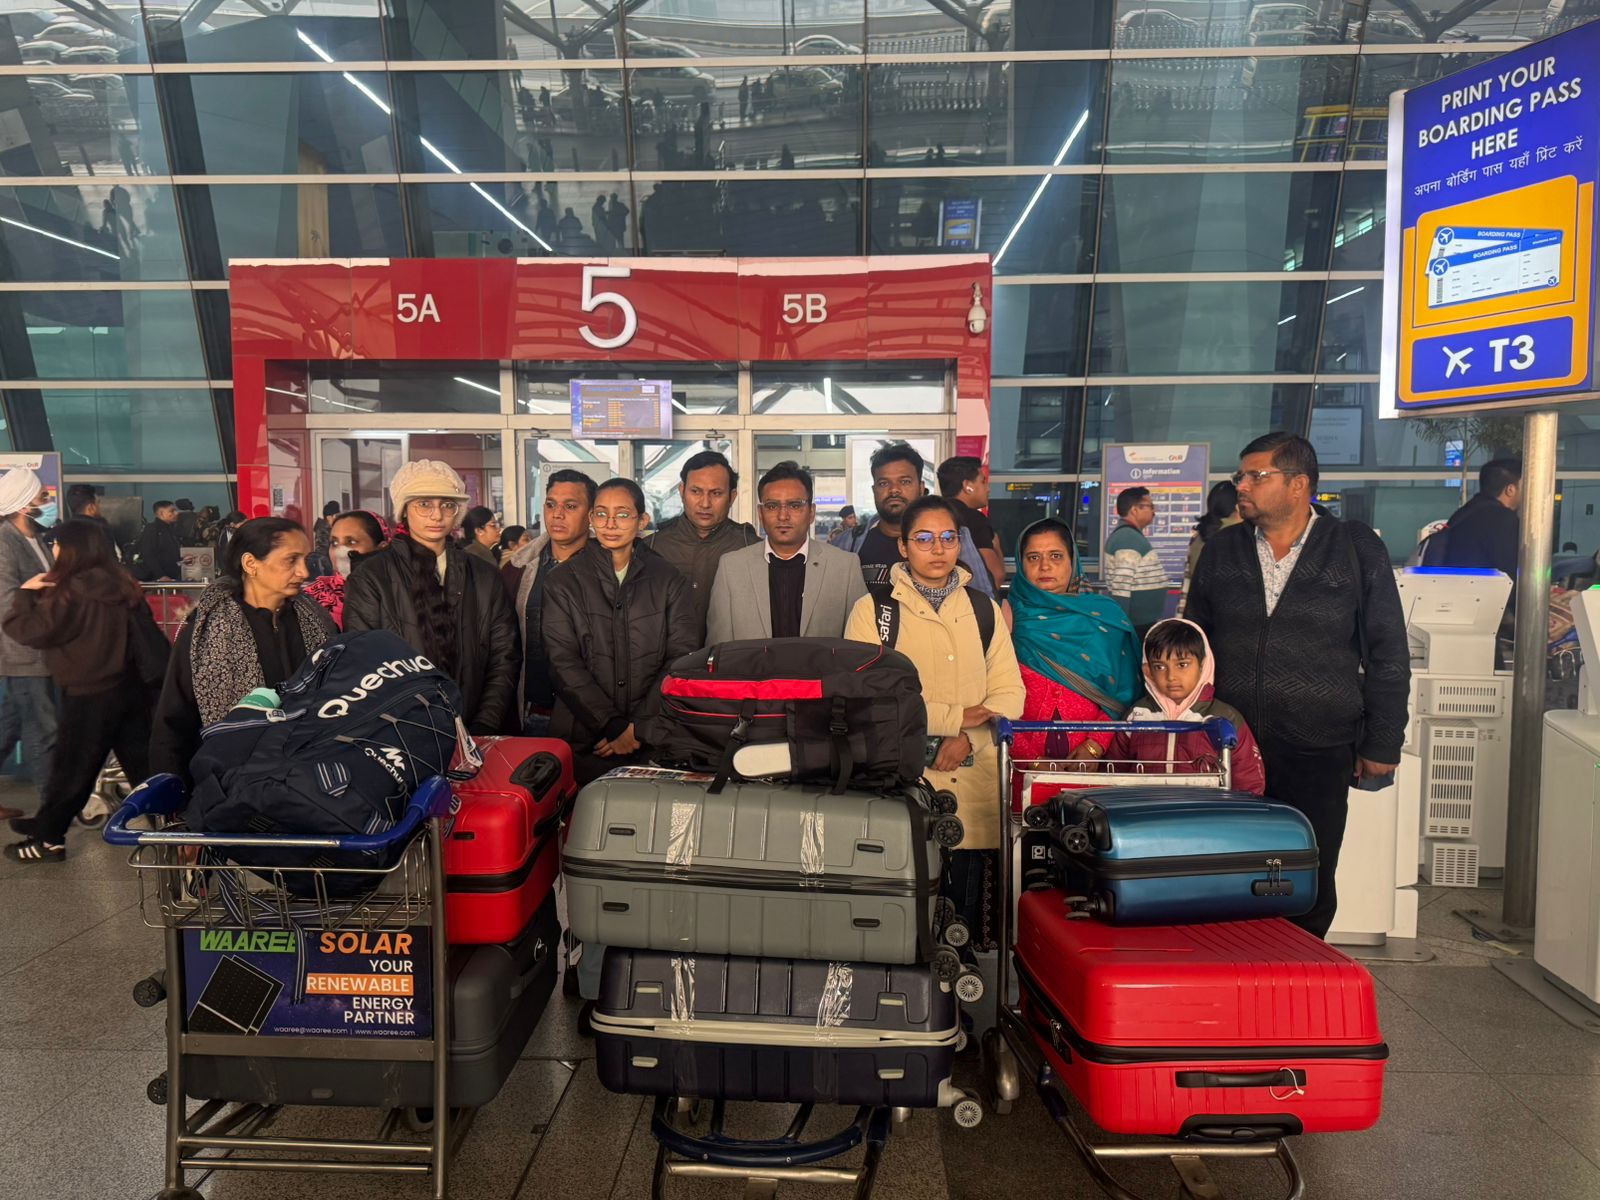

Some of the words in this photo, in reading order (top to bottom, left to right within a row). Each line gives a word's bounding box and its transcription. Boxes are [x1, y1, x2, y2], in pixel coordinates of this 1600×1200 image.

[1441, 79, 1493, 113] PRINT
[1498, 56, 1556, 92] YOUR
[1418, 98, 1523, 148] BOARDING
[1529, 77, 1582, 112] PASS
[1471, 128, 1519, 160] HERE
[1414, 179, 1441, 196] अपना
[1446, 169, 1477, 188] बोर्डिंग
[1482, 161, 1503, 177] पास
[1509, 151, 1530, 170] यहाँ
[1536, 146, 1557, 163] प्रिंट
[1564, 135, 1583, 155] करें
[1473, 248, 1501, 259] BOARDING
[1502, 244, 1518, 252] PASS
[397, 293, 441, 323] 5A
[578, 265, 638, 349] 5
[782, 293, 827, 324] 5B
[1489, 334, 1536, 372] T3
[878, 604, 893, 642] safari
[317, 655, 437, 719] Quechua
[364, 748, 404, 784] Quechu
[320, 932, 413, 955] SOLAR
[369, 959, 413, 973] YOUR
[306, 976, 410, 992] RENEWABLE
[344, 1011, 415, 1025] PARTNER
[352, 997, 414, 1011] ENERGY
[274, 1026, 348, 1034] waaree@waaree.com
